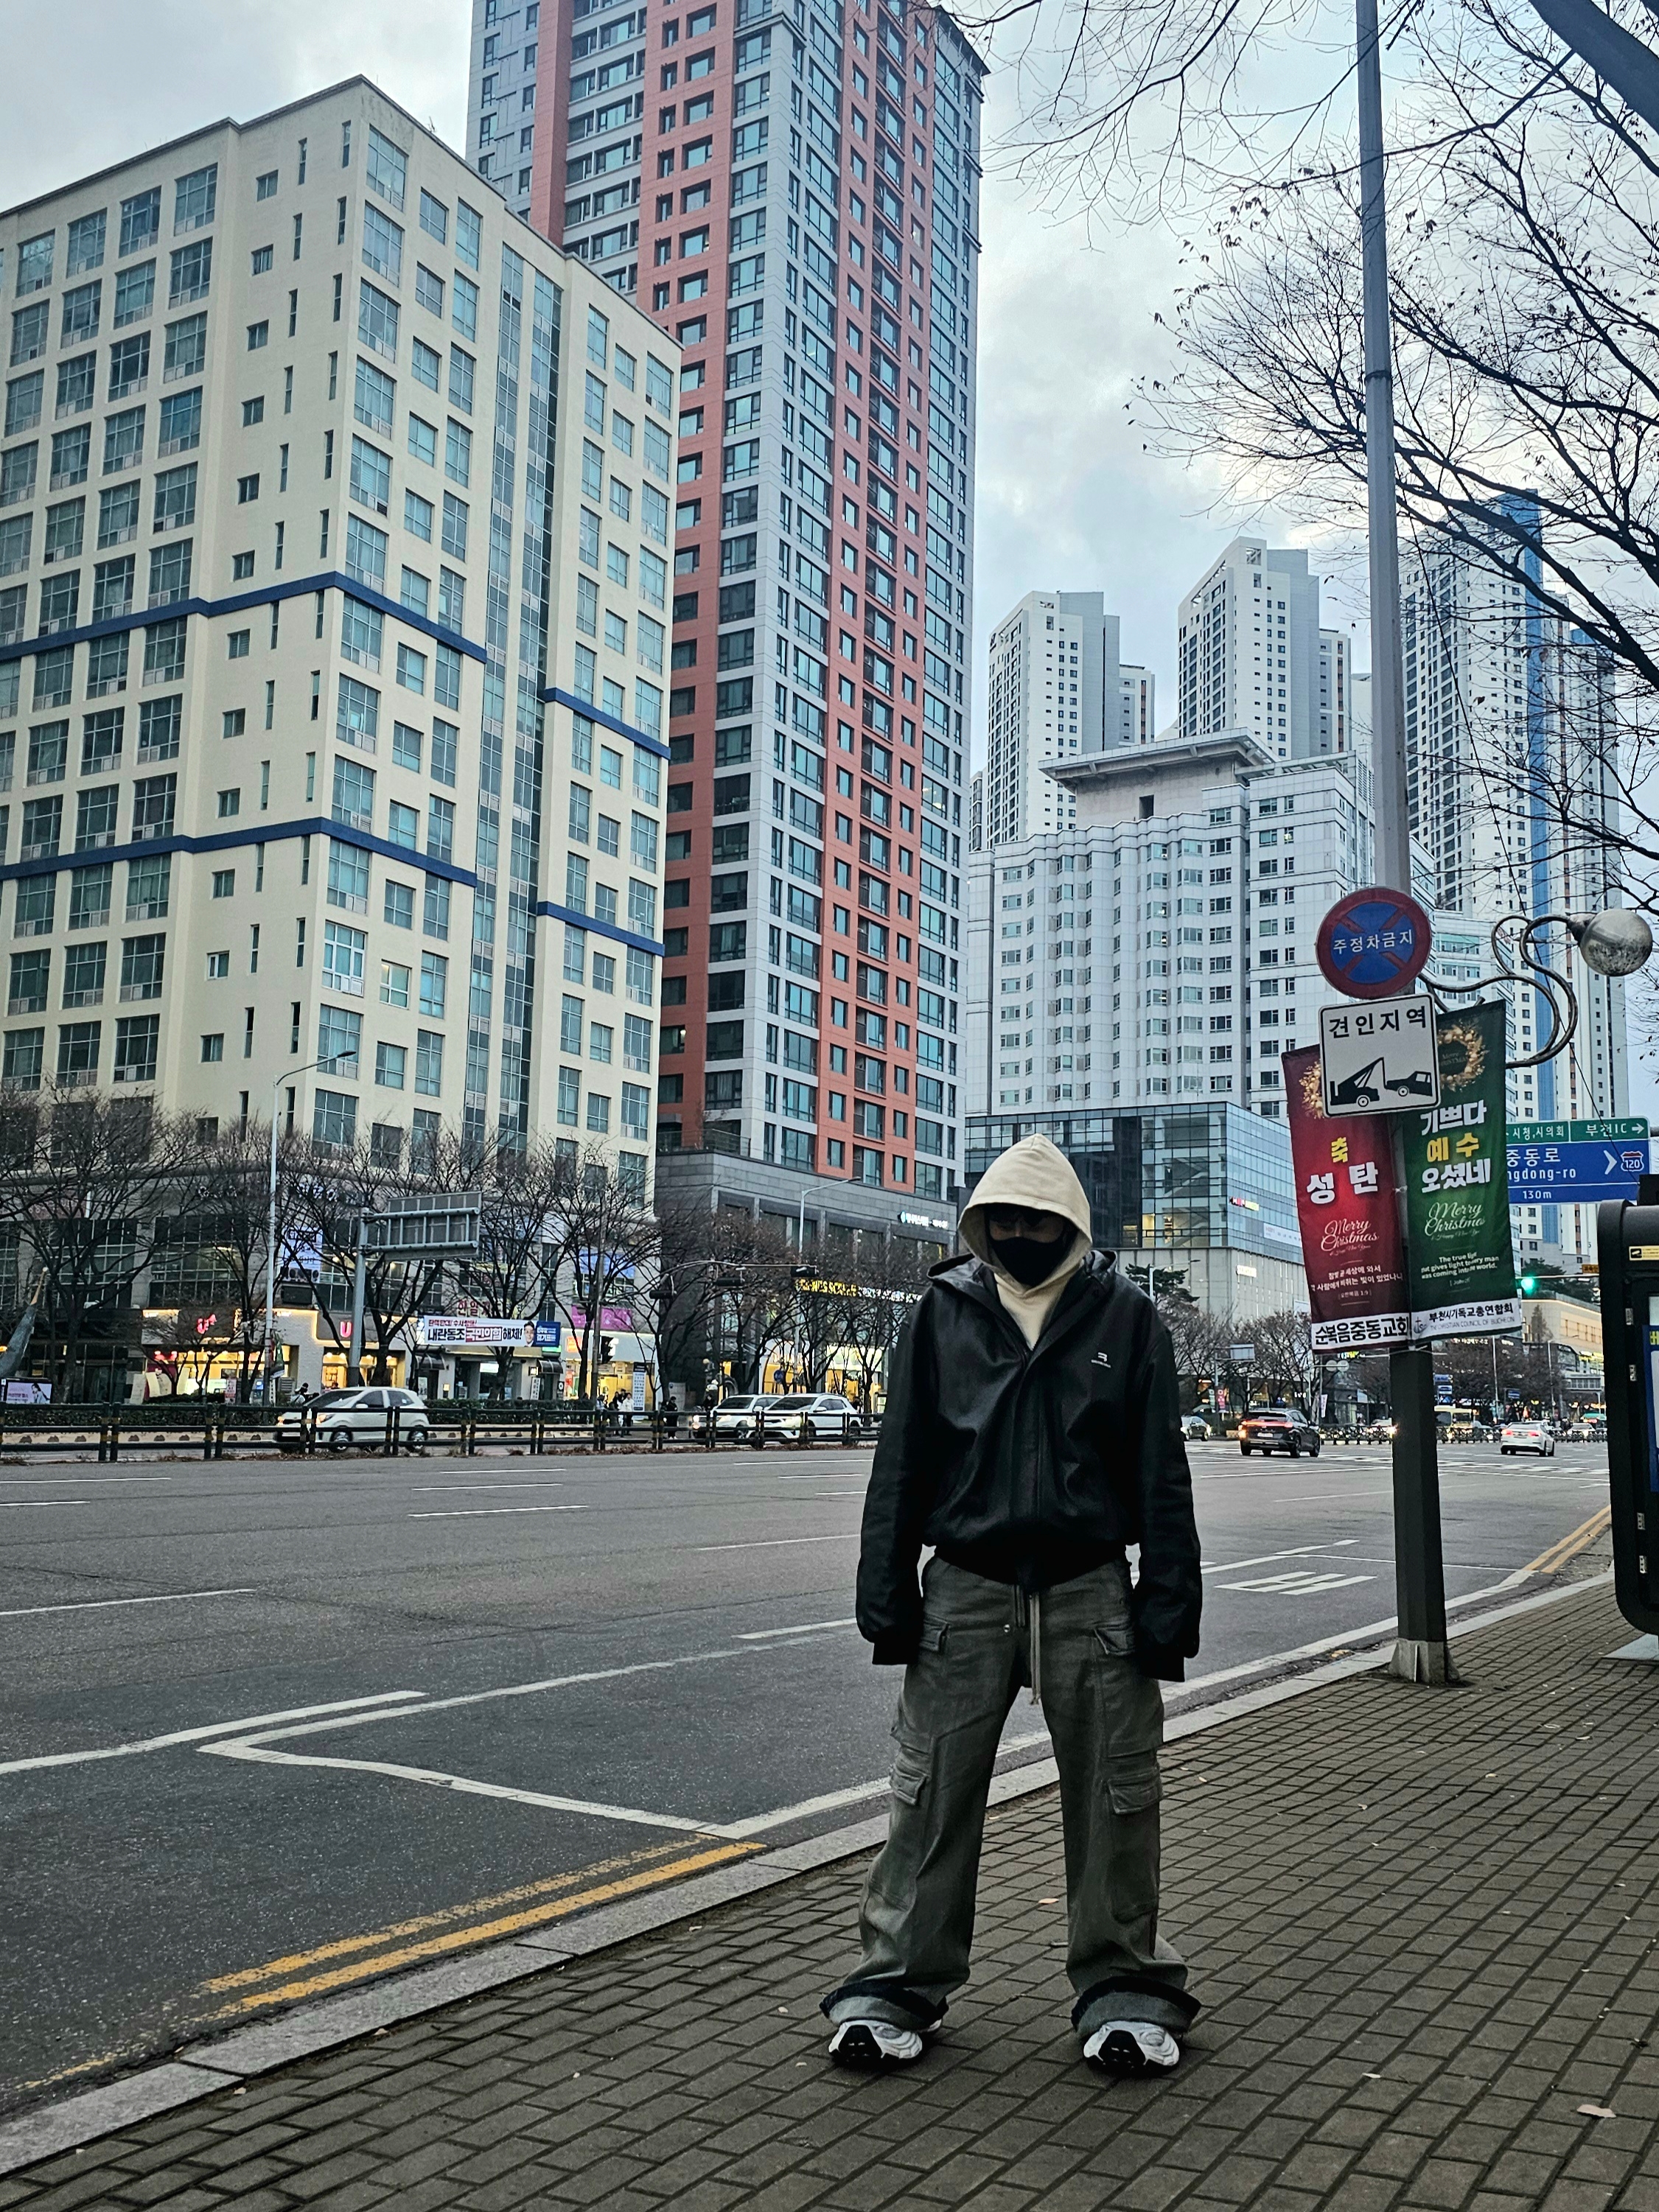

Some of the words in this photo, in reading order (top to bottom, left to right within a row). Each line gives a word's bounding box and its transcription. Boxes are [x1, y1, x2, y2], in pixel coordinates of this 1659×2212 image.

[1333, 929, 1413, 954] 주정차금지
[1328, 1006, 1426, 1038] 견인지역
[1420, 1099, 1487, 1135] 기쁘다
[1512, 1125, 1564, 1141] 시청,시의회
[1585, 1123, 1627, 1138] 부천IC
[1331, 1137, 1349, 1163] 축
[1506, 1148, 1561, 1167] 중동로
[1624, 1159, 1641, 1169] 120
[1421, 1158, 1491, 1194] 오셨네
[1506, 1167, 1576, 1183] ngdong-ro
[1522, 1190, 1552, 1200] 130m
[1428, 1202, 1484, 1219] Merry
[1324, 1218, 1372, 1235] Merry
[1320, 1231, 1380, 1252] Christmas
[1366, 1264, 1382, 1273] 와서
[1431, 1264, 1447, 1273] gives
[1448, 1261, 1464, 1270] light
[1433, 1269, 1458, 1278] coming
[1428, 1302, 1514, 1323] 부천시기독교총연합회
[427, 1328, 465, 1341] 내란동조
[467, 1327, 502, 1342] 국민의힘
[503, 1327, 523, 1340] 해체!
[1315, 1316, 1409, 1345] 순복음중동교회
